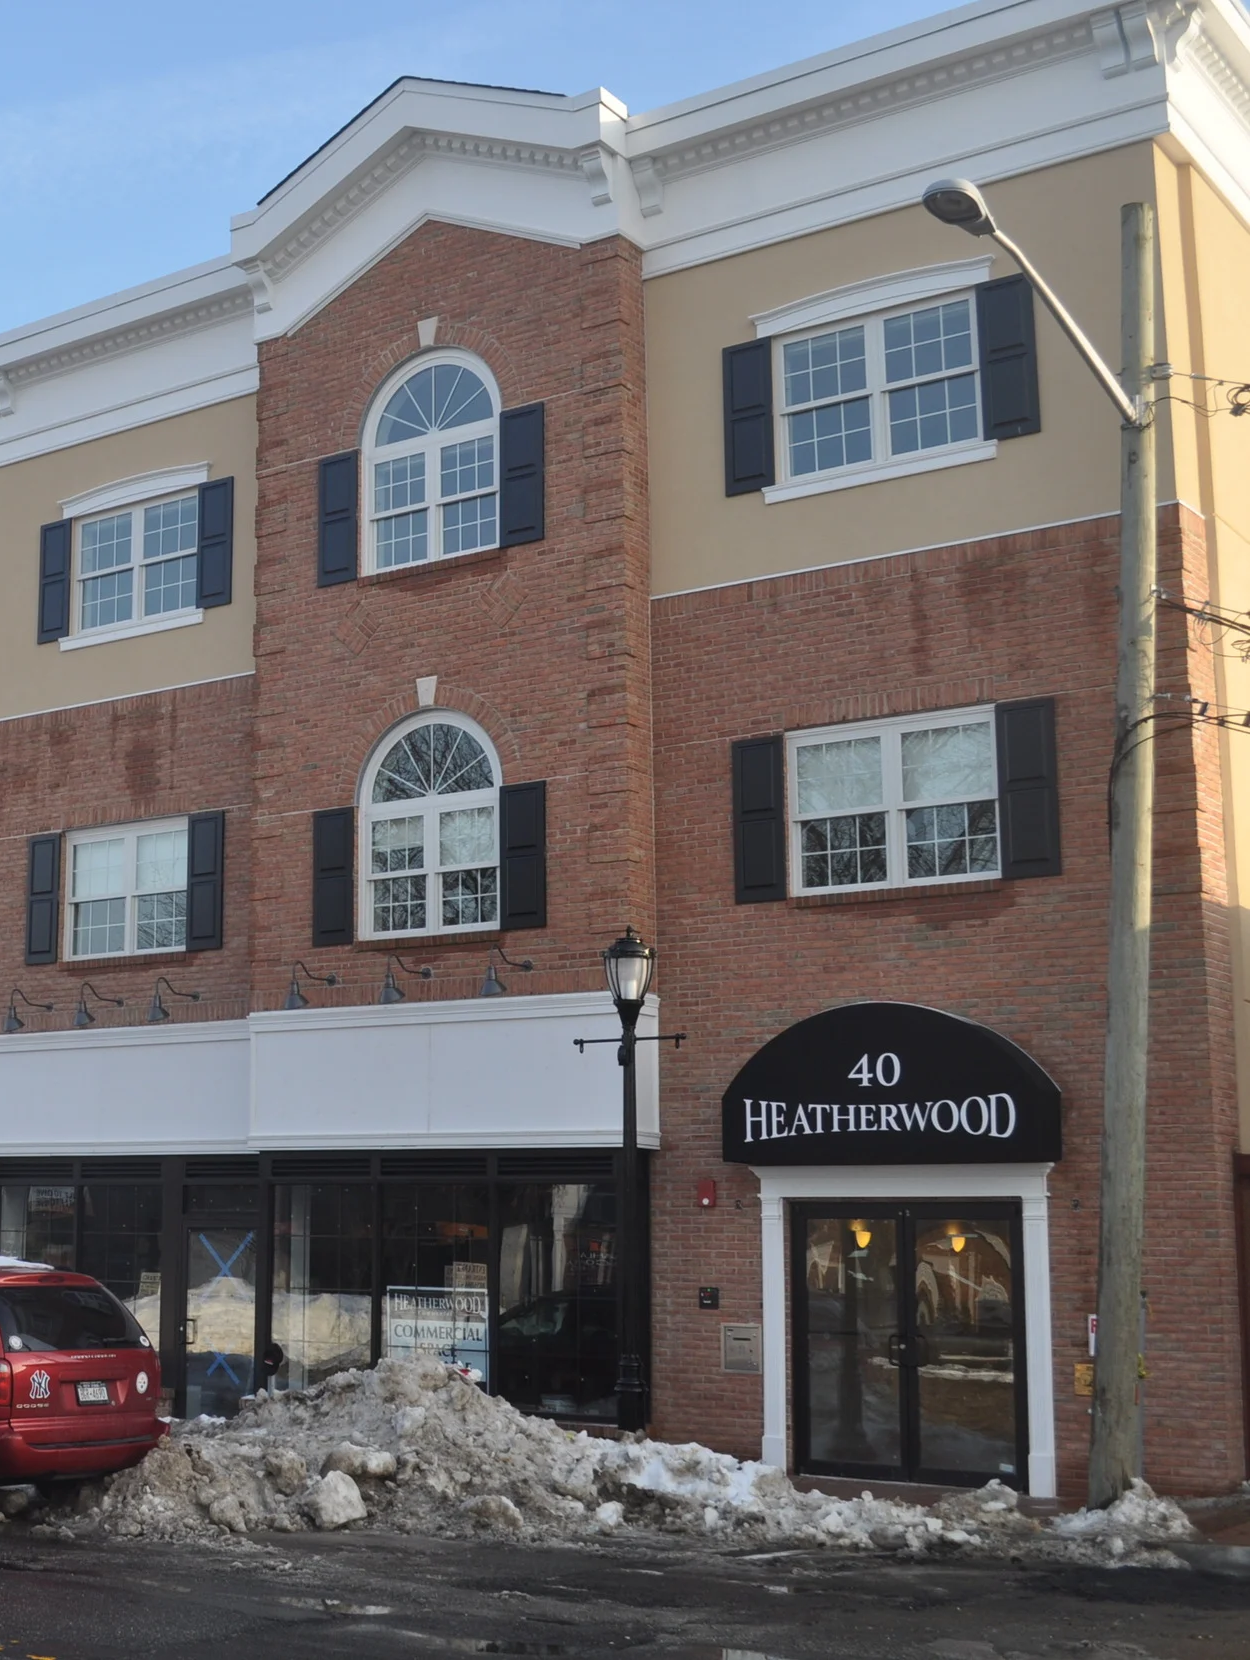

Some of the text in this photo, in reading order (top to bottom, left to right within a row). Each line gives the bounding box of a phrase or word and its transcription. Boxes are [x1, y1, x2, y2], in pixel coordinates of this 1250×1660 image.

[847, 1052, 901, 1087] 40
[743, 1093, 1016, 1142] HEATHERWOOD
[394, 1293, 481, 1314] HEATHERWOOD
[394, 1324, 483, 1341] COMMERCIAL
[420, 1343, 458, 1357] SPACE
